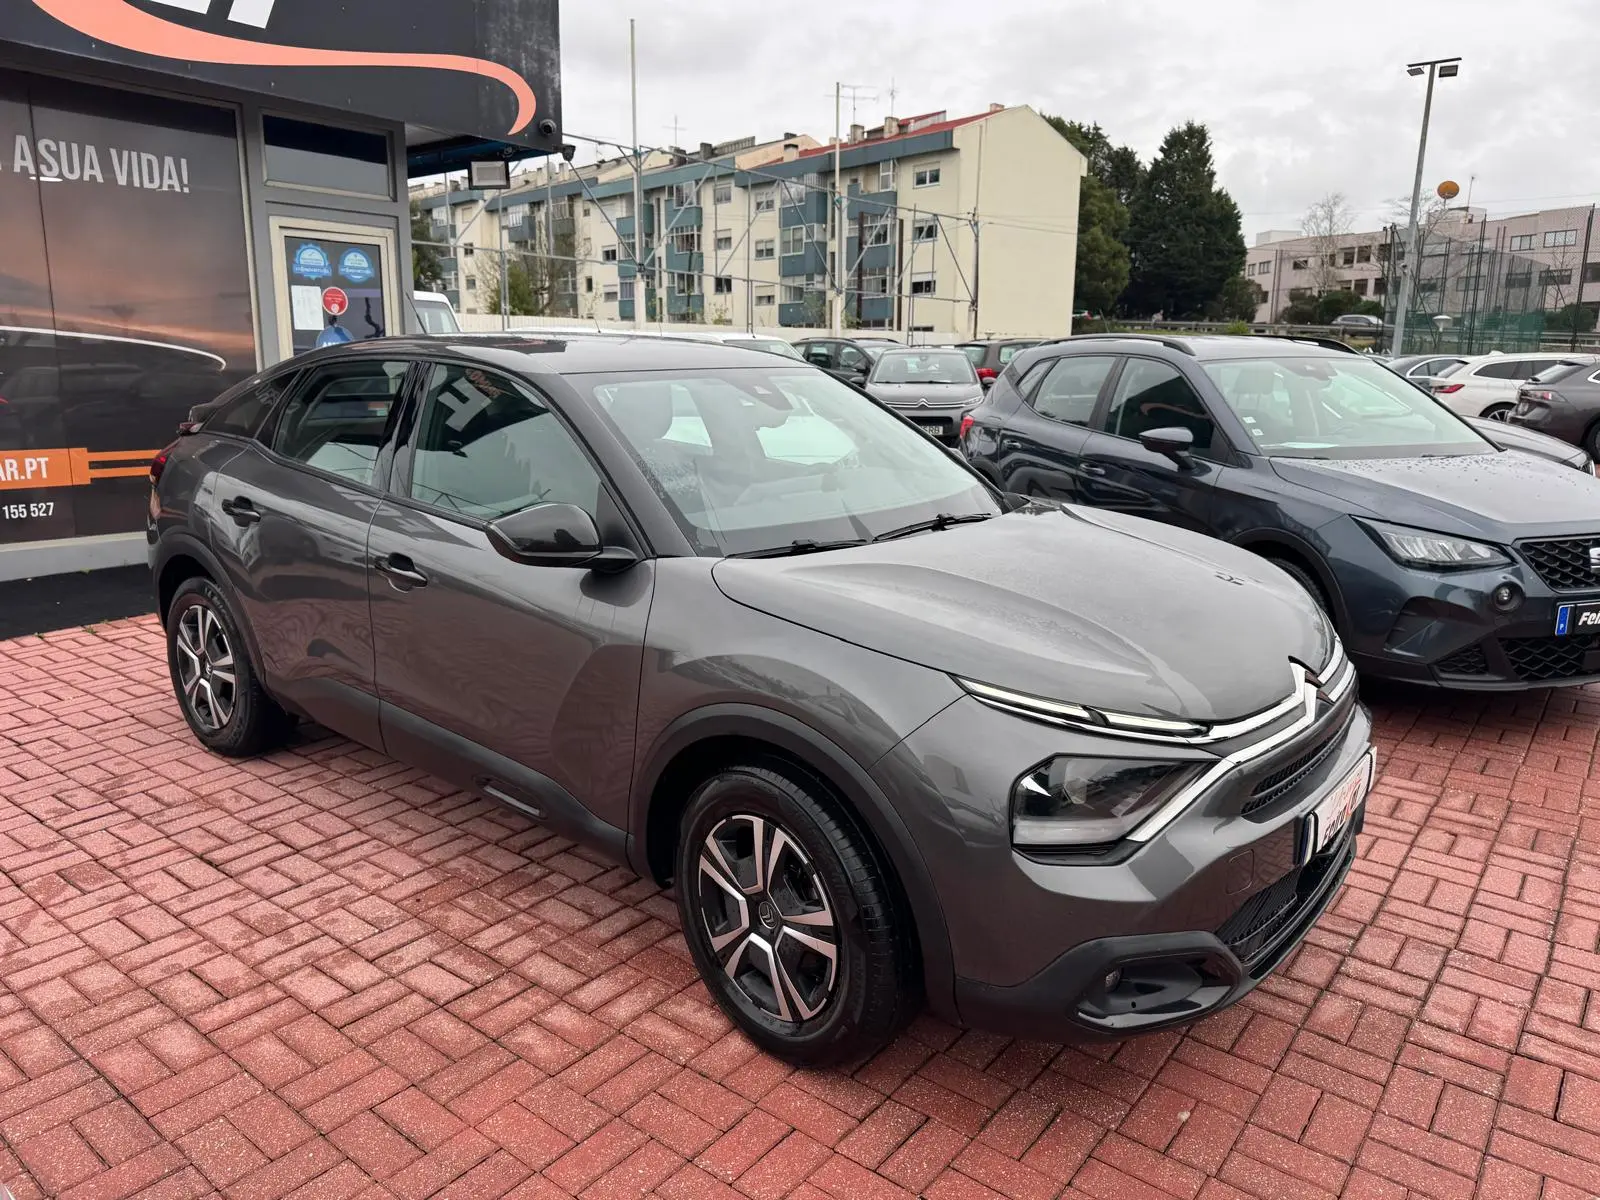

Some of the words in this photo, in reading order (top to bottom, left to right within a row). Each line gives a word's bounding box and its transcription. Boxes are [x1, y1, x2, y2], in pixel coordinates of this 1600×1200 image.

[109, 147, 190, 193] VIDA!
[2, 503, 27, 519] 155
[30, 502, 54, 517] 527
[1578, 610, 1600, 626] Fei
